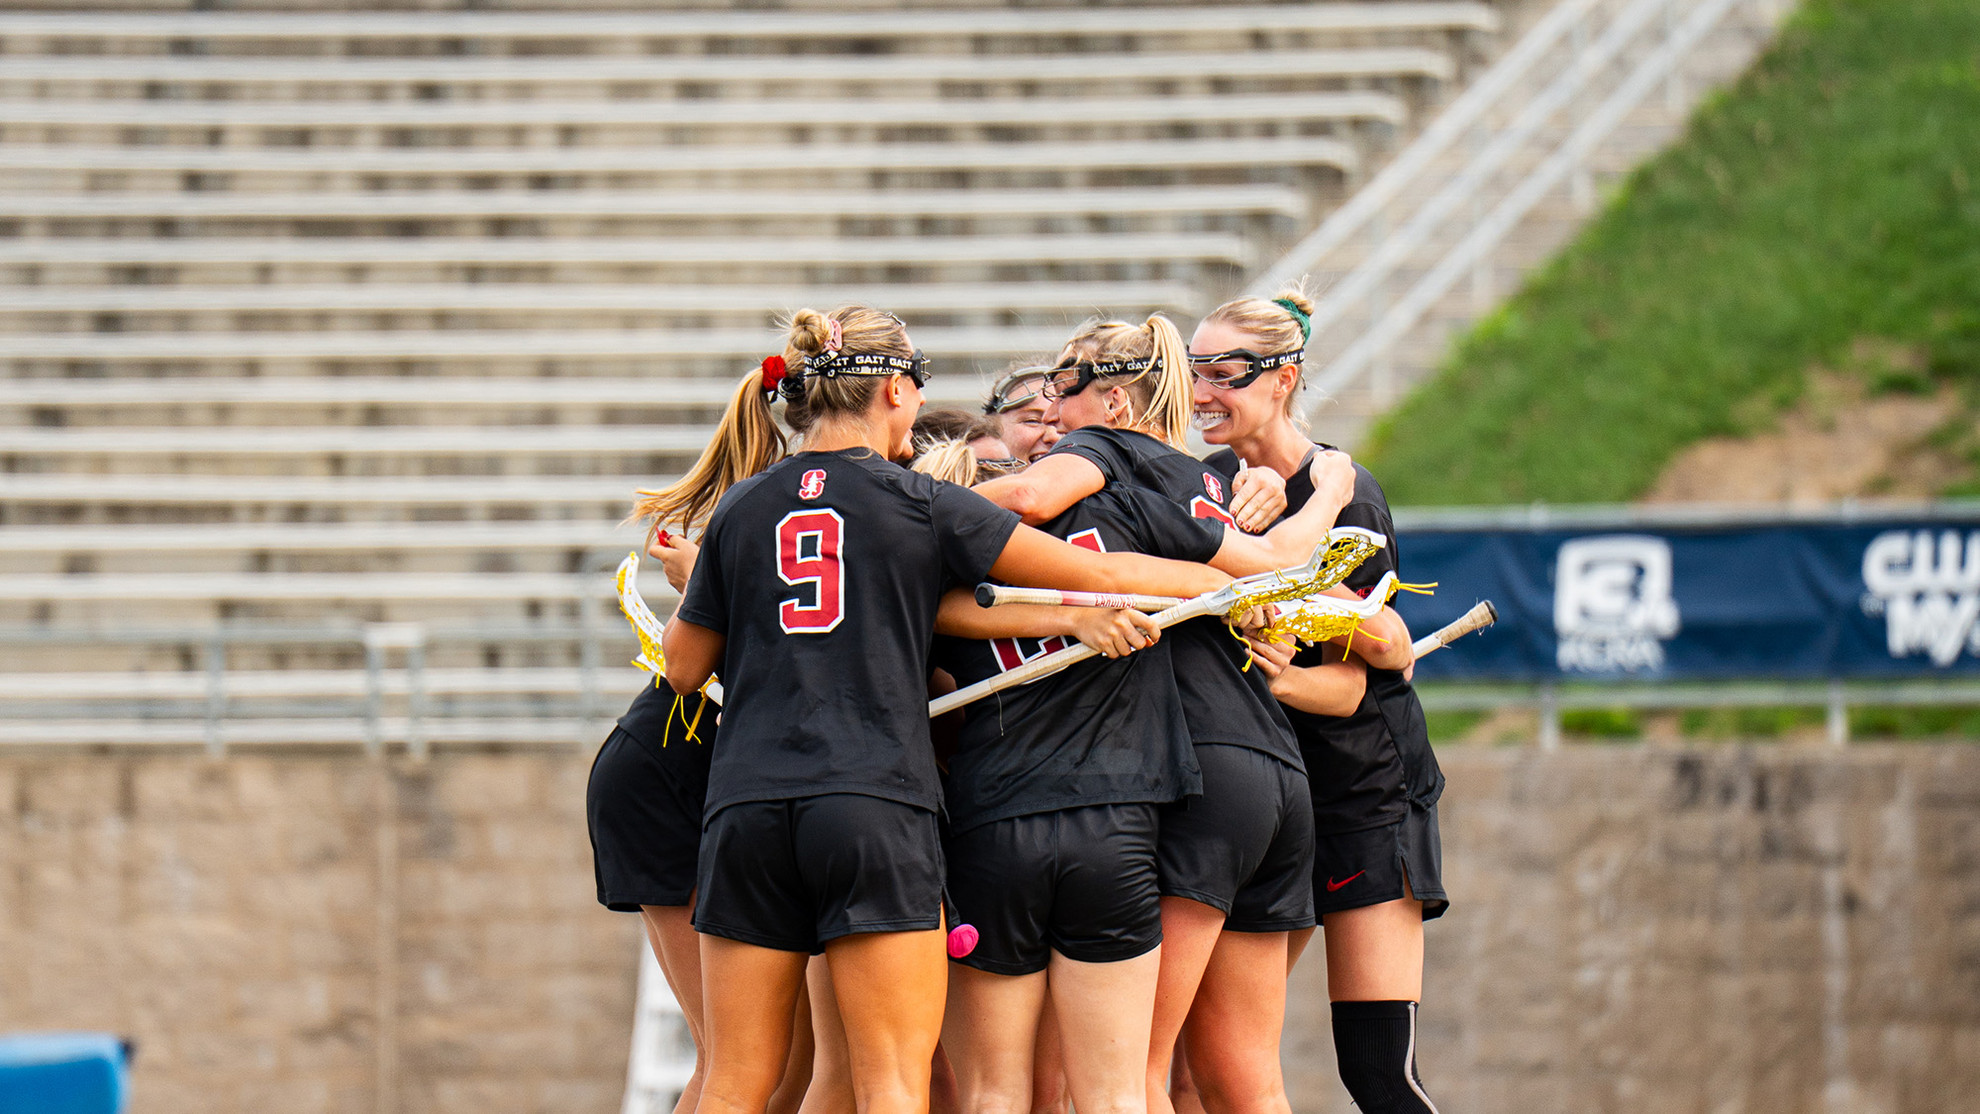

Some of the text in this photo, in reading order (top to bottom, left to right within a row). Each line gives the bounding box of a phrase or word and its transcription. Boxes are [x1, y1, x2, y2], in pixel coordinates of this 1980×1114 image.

[855, 355, 885, 365] GAIT
[889, 357, 913, 370] GAIT
[1092, 363, 1121, 373] GAIT
[1260, 358, 1276, 369] AIT
[1279, 353, 1298, 366] GAIT
[775, 507, 845, 635] 9
[1094, 594, 1137, 609] CARDINAL
